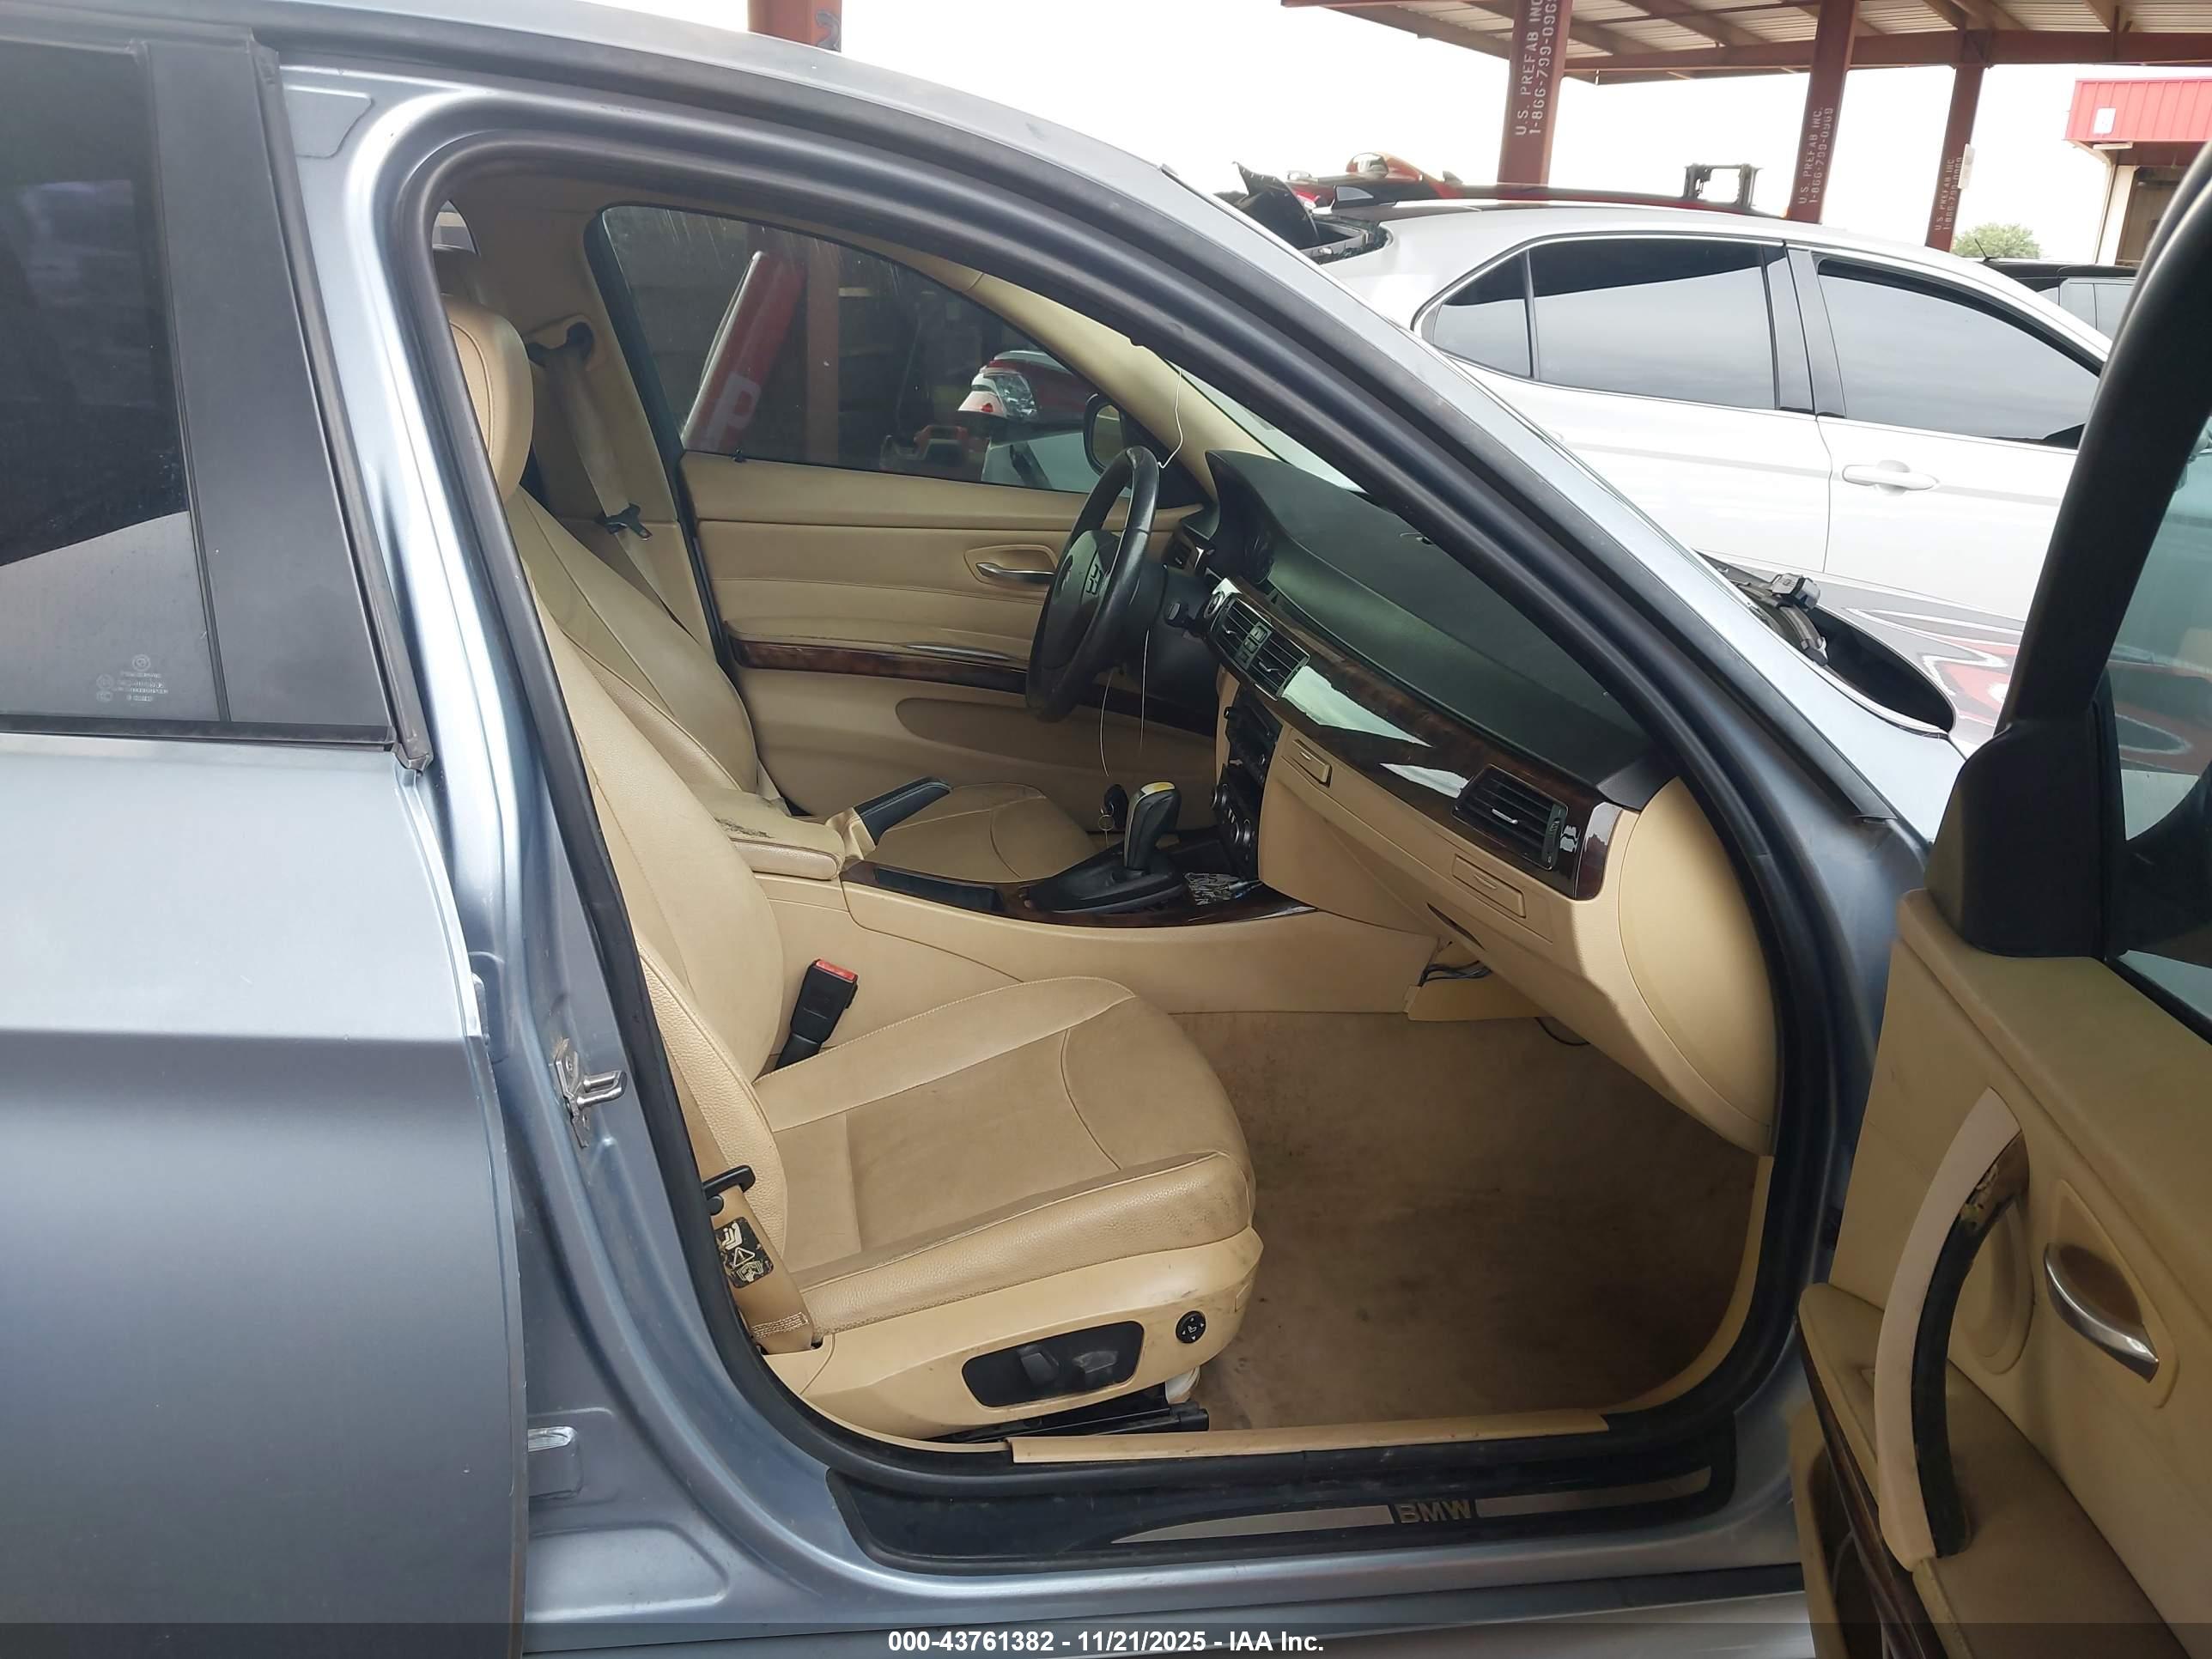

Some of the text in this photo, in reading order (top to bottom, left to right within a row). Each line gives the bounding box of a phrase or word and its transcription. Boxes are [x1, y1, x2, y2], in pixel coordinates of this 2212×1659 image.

[1520, 31, 1539, 95] PREFAB
[1528, 0, 1560, 135] 1-866-799-096
[1516, 105, 1530, 136] U.S.
[1803, 133, 1818, 178] PREFAB
[1798, 183, 1811, 204] U.S.
[1394, 1498, 1472, 1523] BMW
